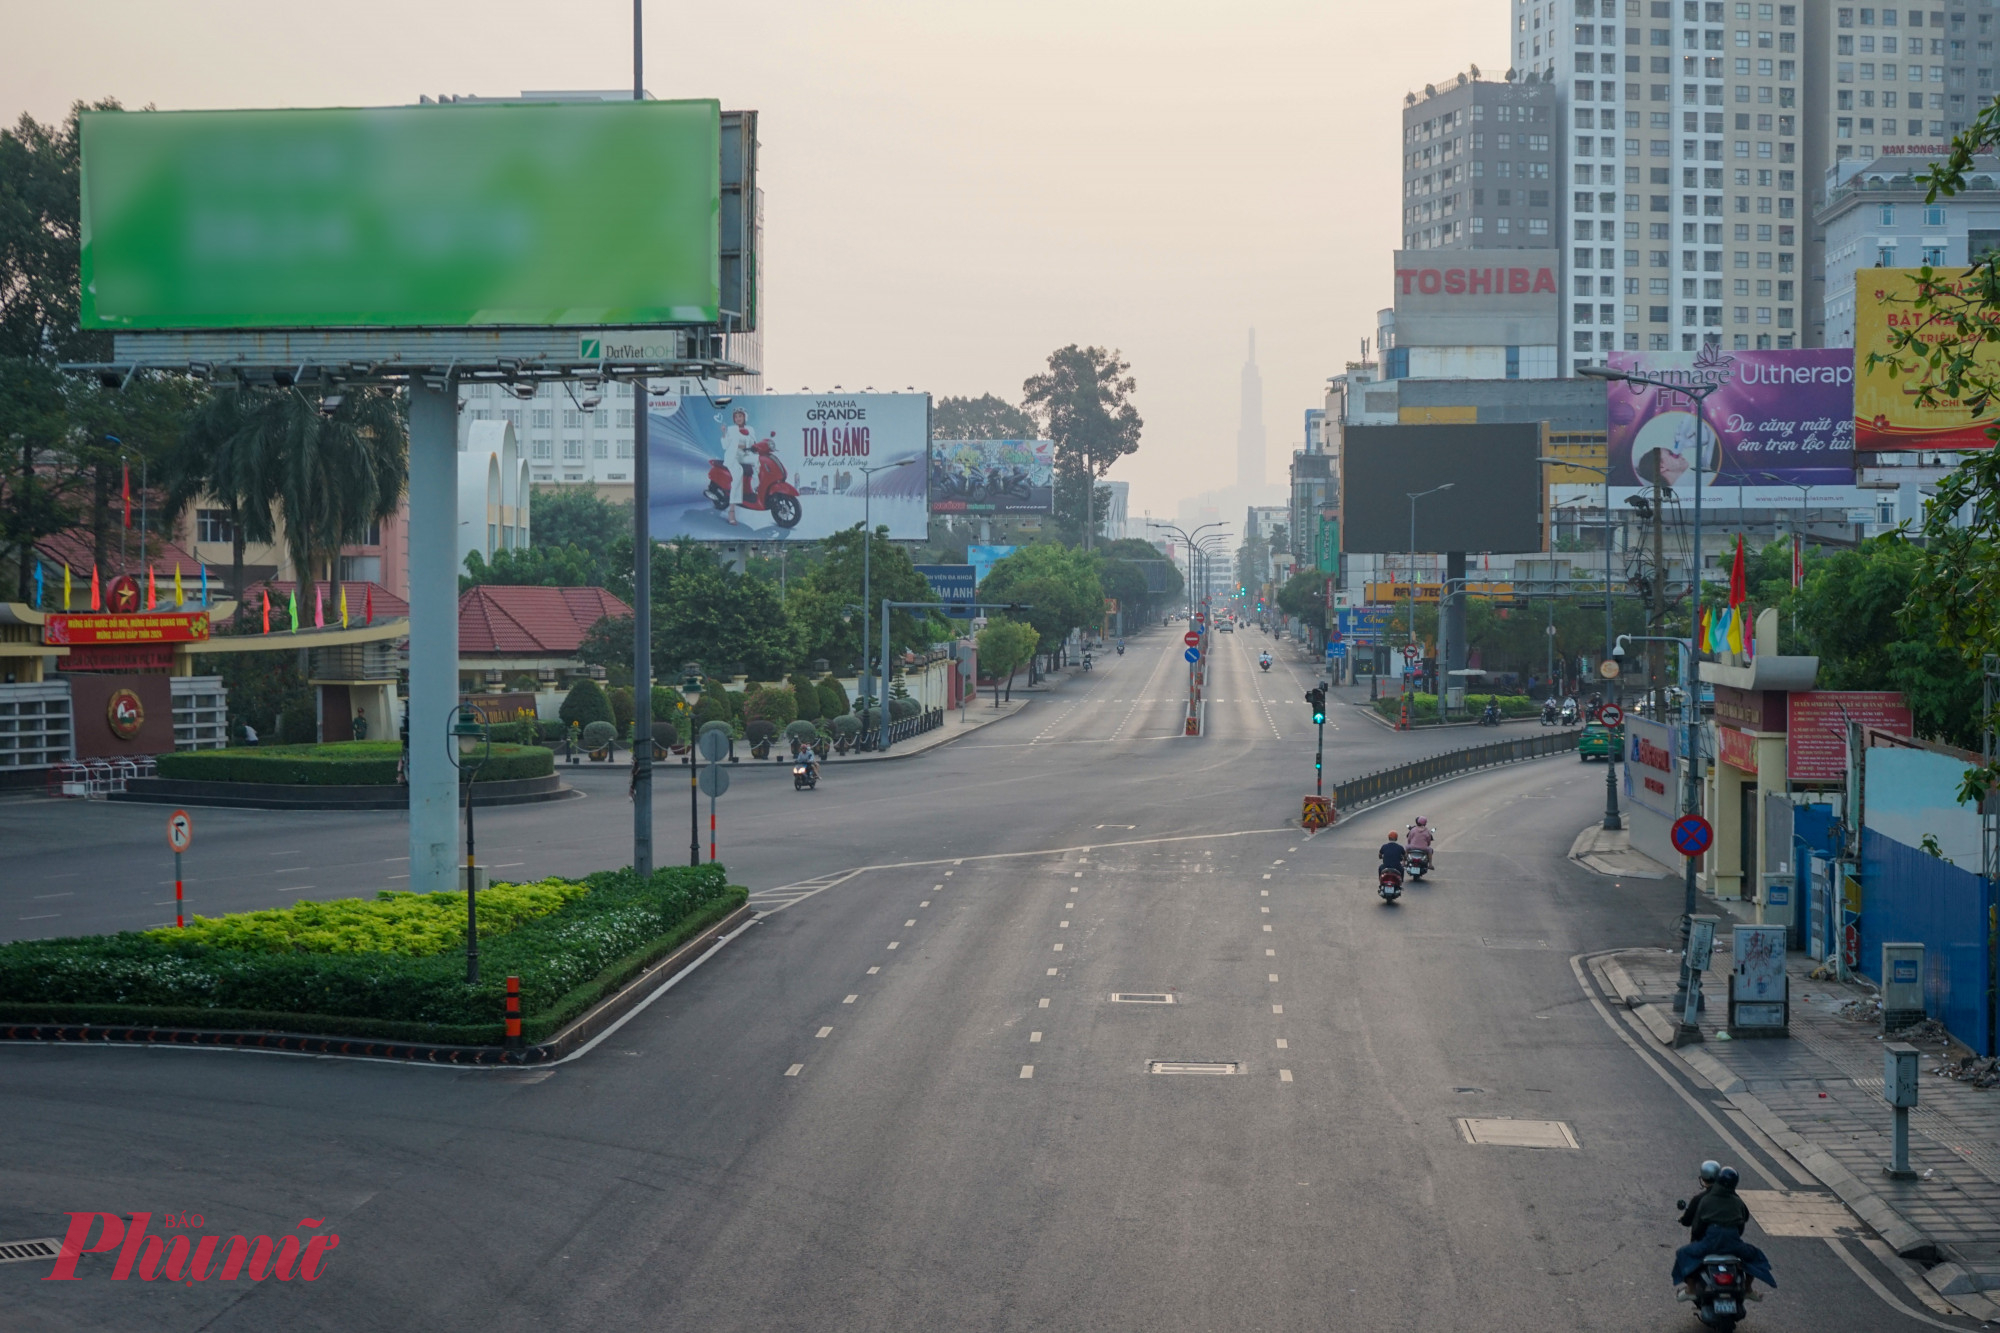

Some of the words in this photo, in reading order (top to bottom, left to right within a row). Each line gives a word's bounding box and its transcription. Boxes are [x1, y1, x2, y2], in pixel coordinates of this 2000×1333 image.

[1882, 145, 1904, 154] NAM
[1907, 145, 1934, 154] SONG
[1396, 267, 1557, 295] TOSHIBA
[1887, 309, 1923, 330] BẬT
[1740, 363, 1854, 387] Ultherap
[654, 400, 677, 408] YAMAHA
[816, 400, 857, 408] YAMAHA
[806, 408, 867, 421] GRANDE
[1724, 413, 1755, 434] Da
[1759, 418, 1796, 438] căng
[1800, 417, 1832, 434] mặt
[802, 422, 829, 457] TOẢ
[832, 422, 870, 457] SÁNG
[1737, 438, 1762, 452] ôm
[1765, 438, 1798, 454] trọn
[1801, 433, 1826, 454] lộc
[1829, 436, 1852, 450] tài
[803, 459, 826, 468] Phong
[952, 587, 973, 598] ANH
